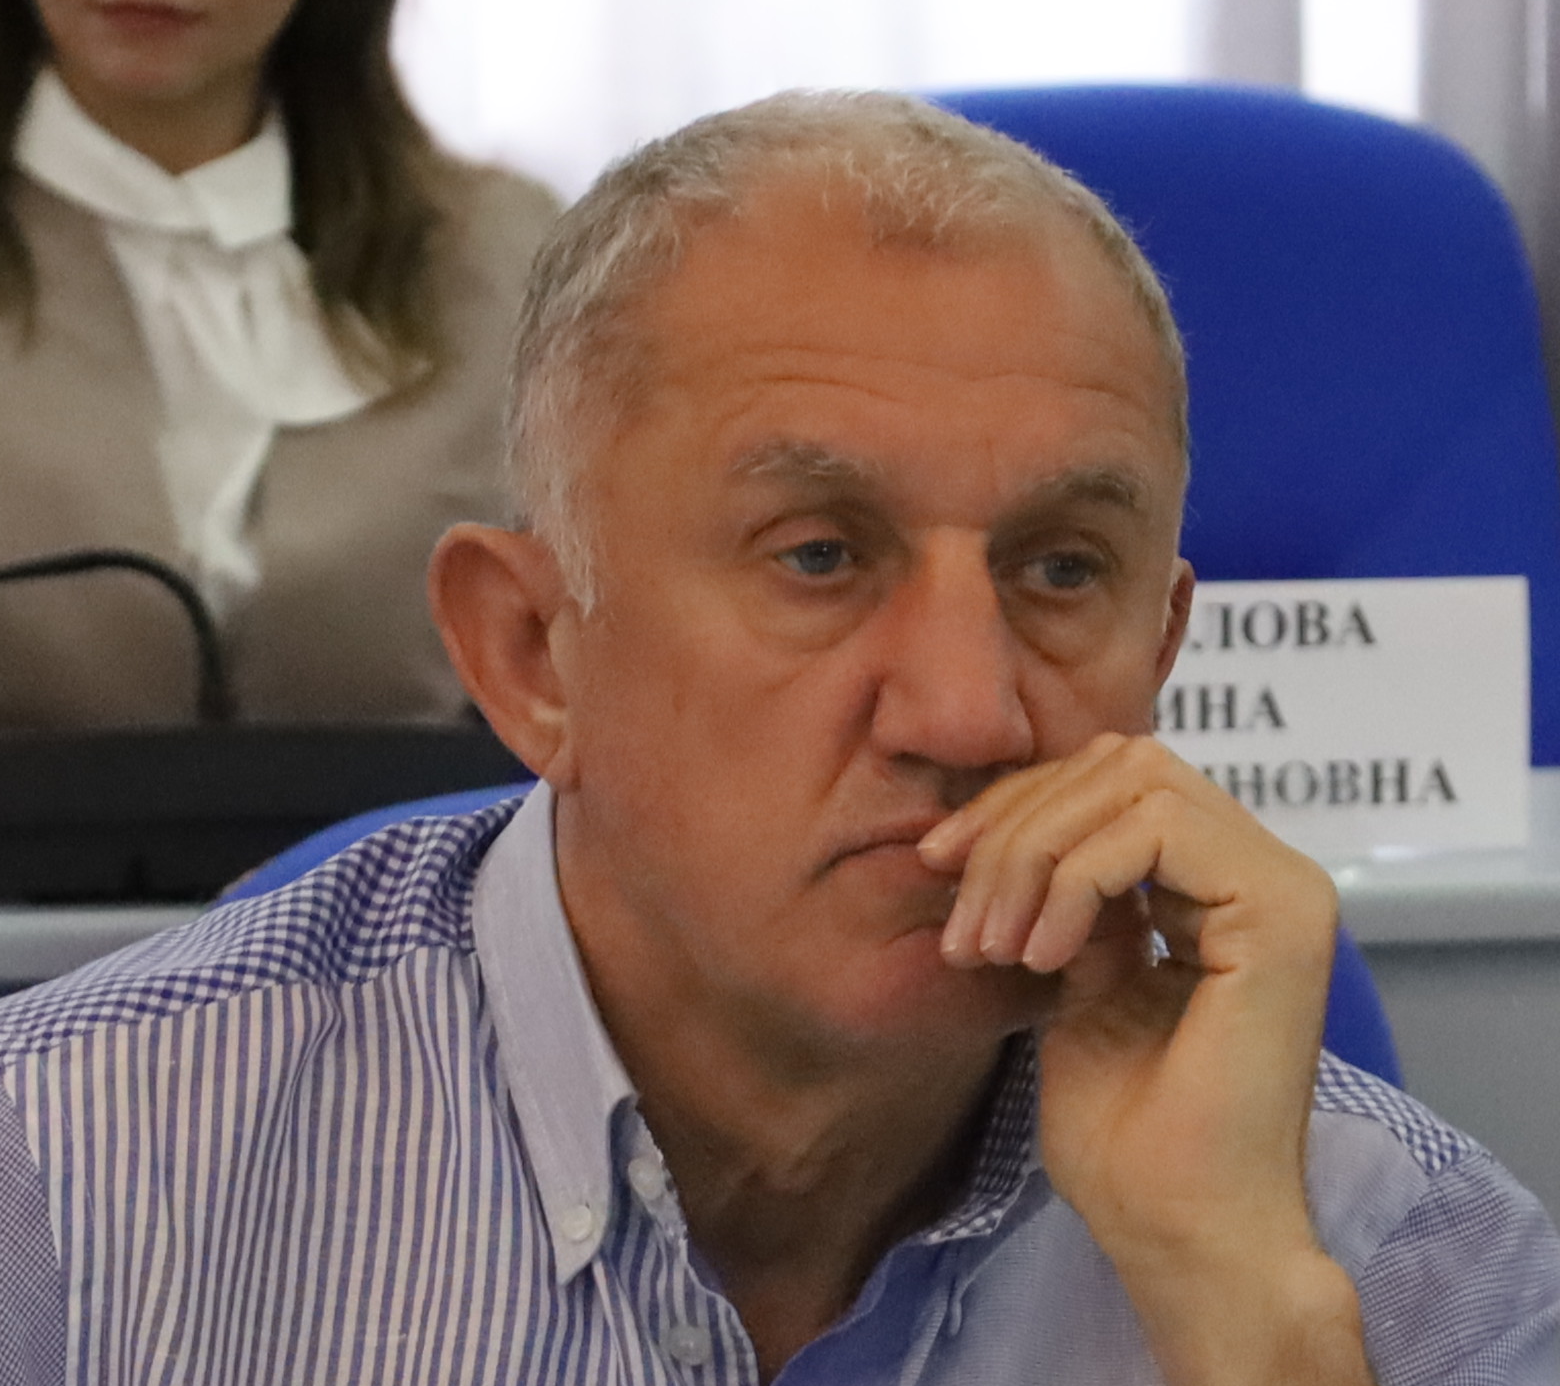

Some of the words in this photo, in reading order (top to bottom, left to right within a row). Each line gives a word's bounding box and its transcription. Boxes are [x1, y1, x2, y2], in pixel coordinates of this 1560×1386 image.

[1187, 600, 1377, 654] ЛОВА
[1153, 683, 1286, 734] ИНА
[1202, 759, 1457, 810] НОВНА
